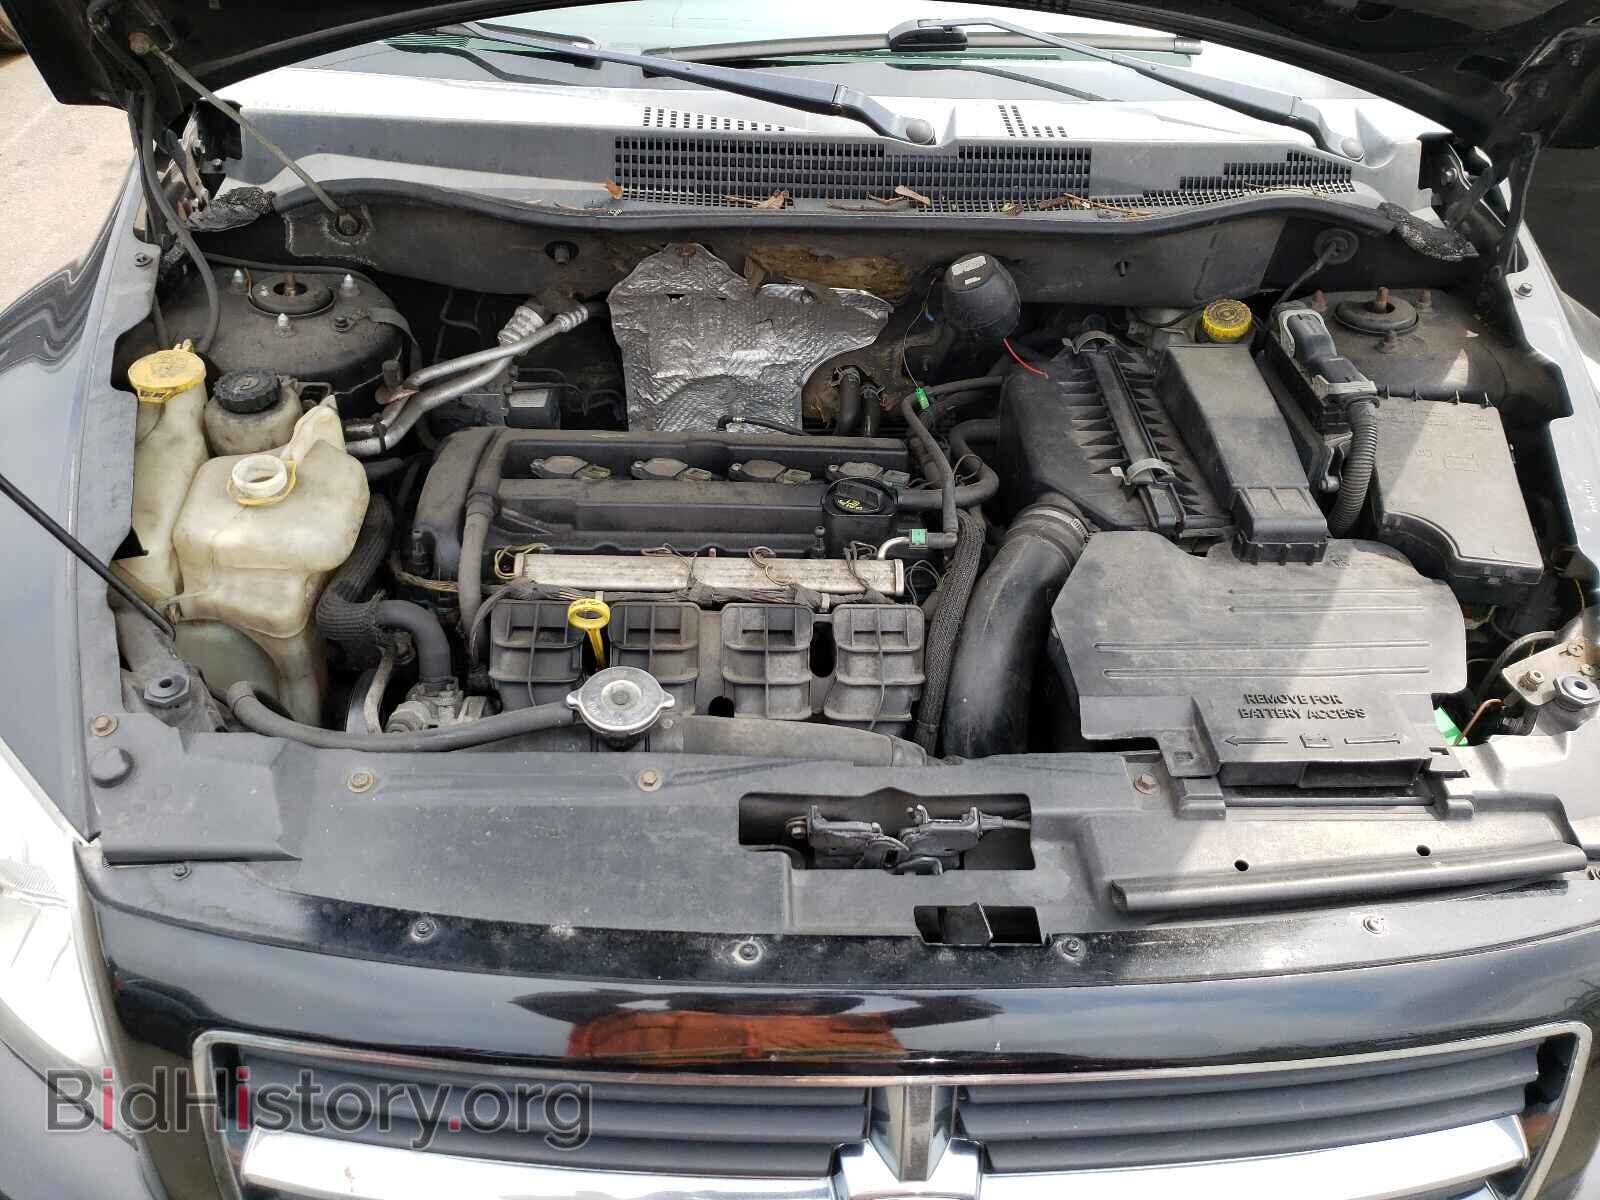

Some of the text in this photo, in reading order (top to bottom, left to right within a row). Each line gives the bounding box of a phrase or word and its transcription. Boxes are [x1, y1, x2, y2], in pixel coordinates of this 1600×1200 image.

[1244, 694, 1343, 704] REMOVE FOR
[1239, 708, 1367, 720] BATTERY ACCESS
